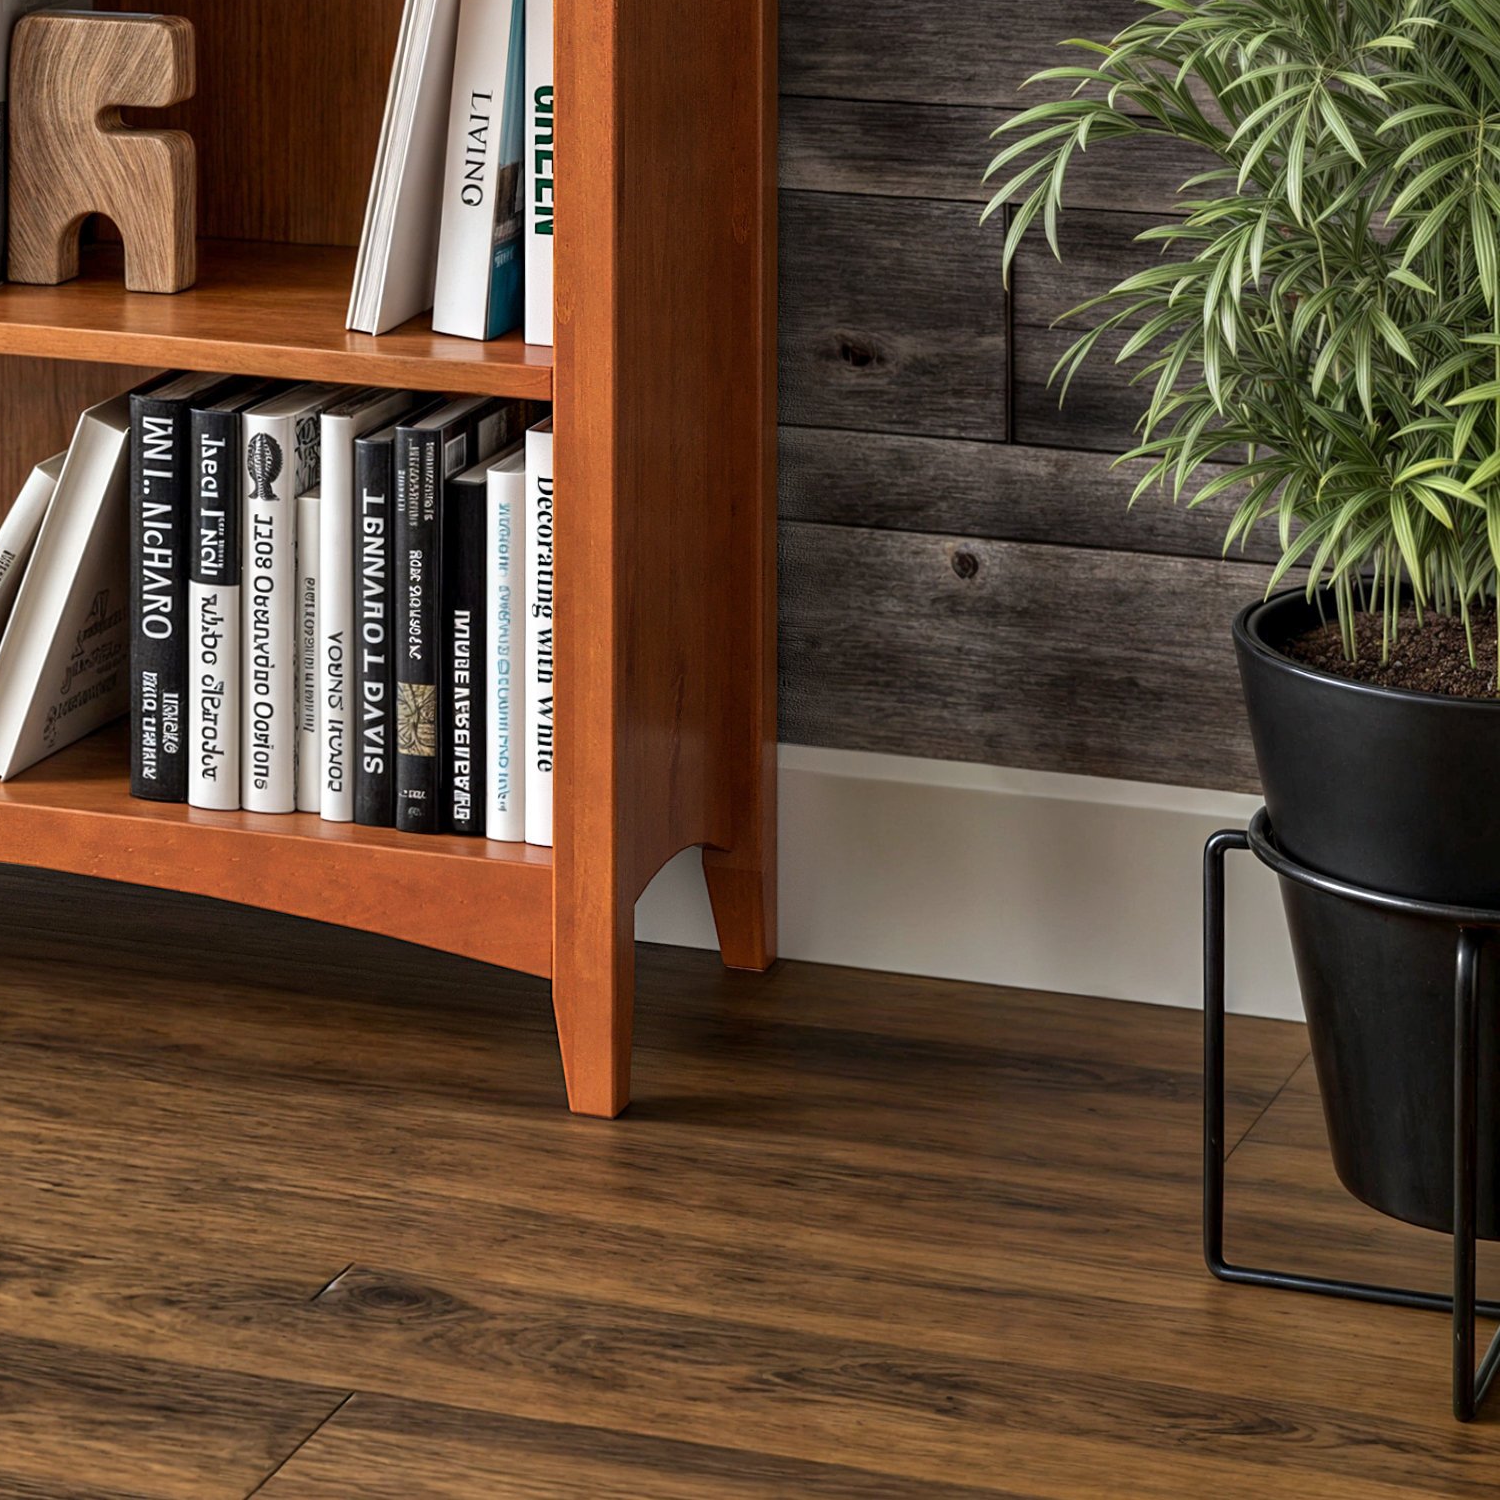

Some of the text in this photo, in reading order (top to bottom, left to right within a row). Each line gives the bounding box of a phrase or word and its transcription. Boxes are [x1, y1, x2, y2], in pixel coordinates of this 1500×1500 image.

[532, 476, 553, 773] Decorating with White
